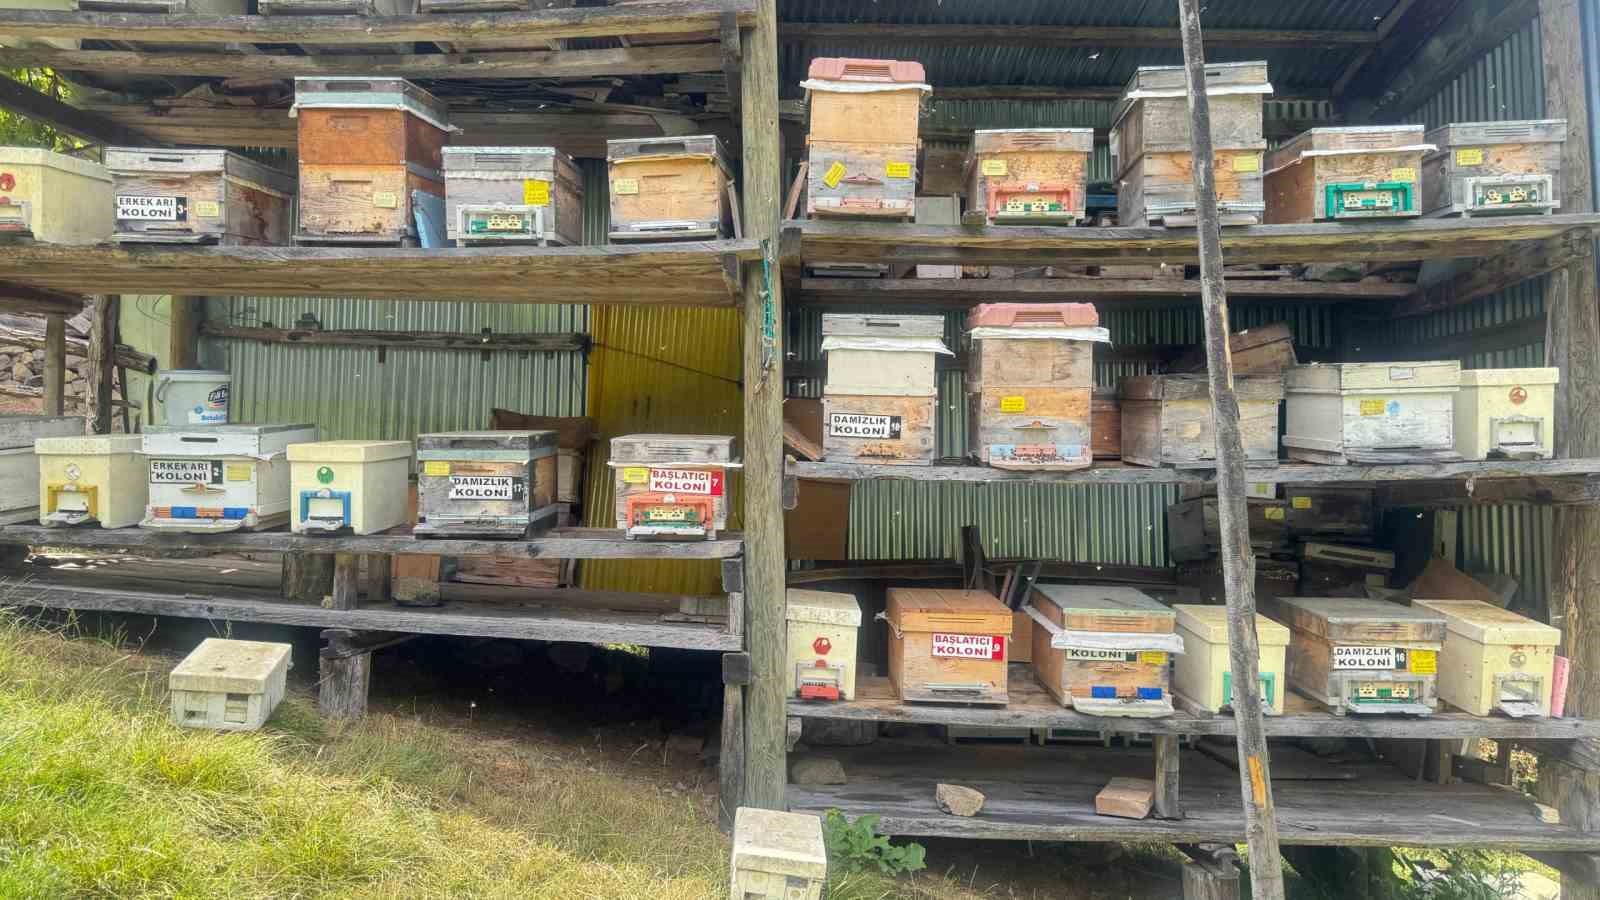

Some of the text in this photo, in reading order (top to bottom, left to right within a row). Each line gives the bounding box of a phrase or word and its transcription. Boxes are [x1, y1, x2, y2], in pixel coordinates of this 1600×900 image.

[119, 197, 174, 207] ERKEK ARI
[121, 208, 172, 217] KOLONİ
[834, 425, 885, 436] KOLONİ
[153, 462, 188, 471] ERKEK
[654, 480, 706, 492] KOLONİ
[711, 478, 720, 488] 7
[455, 488, 508, 497] KOLONİ
[937, 645, 988, 656] KOLONİ
[1338, 658, 1391, 666] KOLONİ
